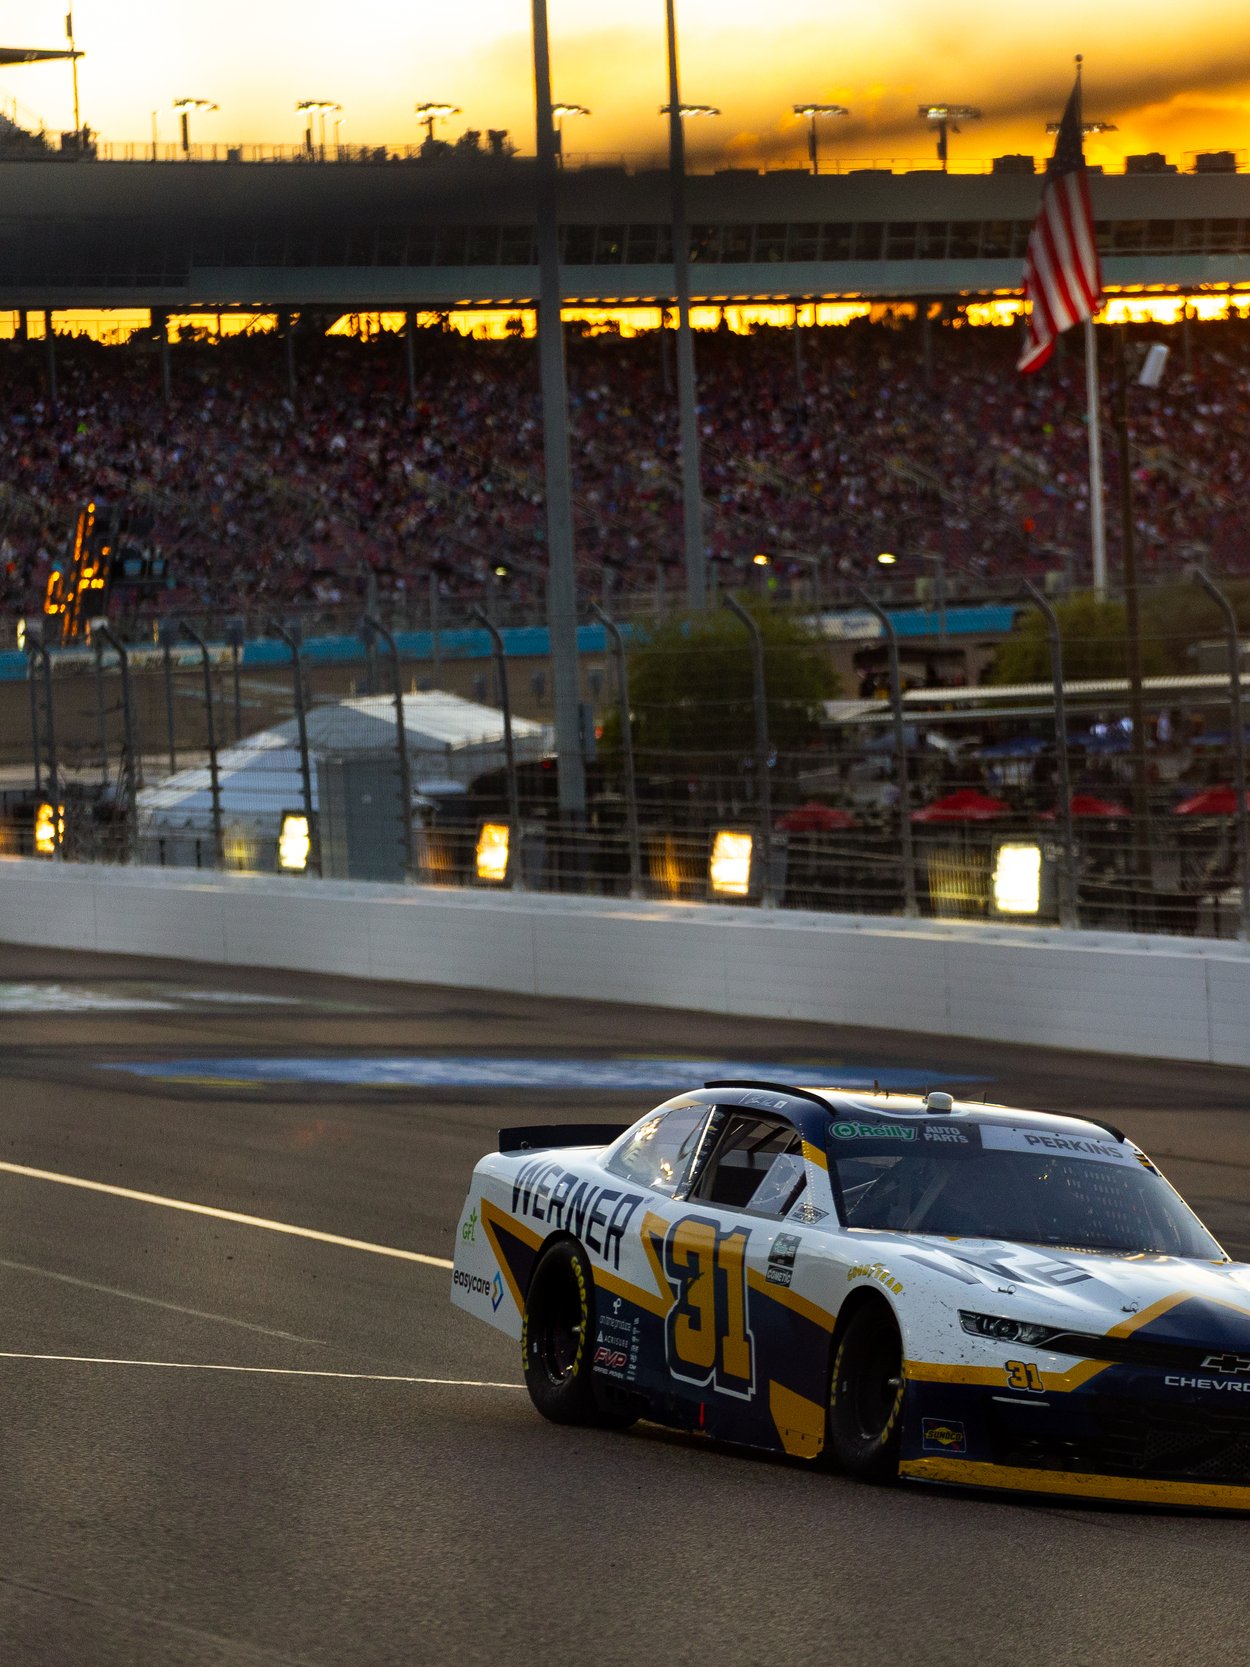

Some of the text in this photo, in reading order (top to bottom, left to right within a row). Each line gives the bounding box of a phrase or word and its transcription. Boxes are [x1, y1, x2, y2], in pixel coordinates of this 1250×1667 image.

[831, 1121, 914, 1140] O'Reilly
[924, 1133, 968, 1143] PARTS
[926, 1126, 960, 1134] AUTO
[1024, 1134, 1124, 1158] PERKINS
[512, 1159, 645, 1271] WERNER
[453, 1269, 491, 1296] easycare
[664, 1215, 754, 1400] 31
[594, 1347, 627, 1368] FVP
[1004, 1360, 1045, 1393] 31
[927, 1430, 963, 1440] SUNOCO
